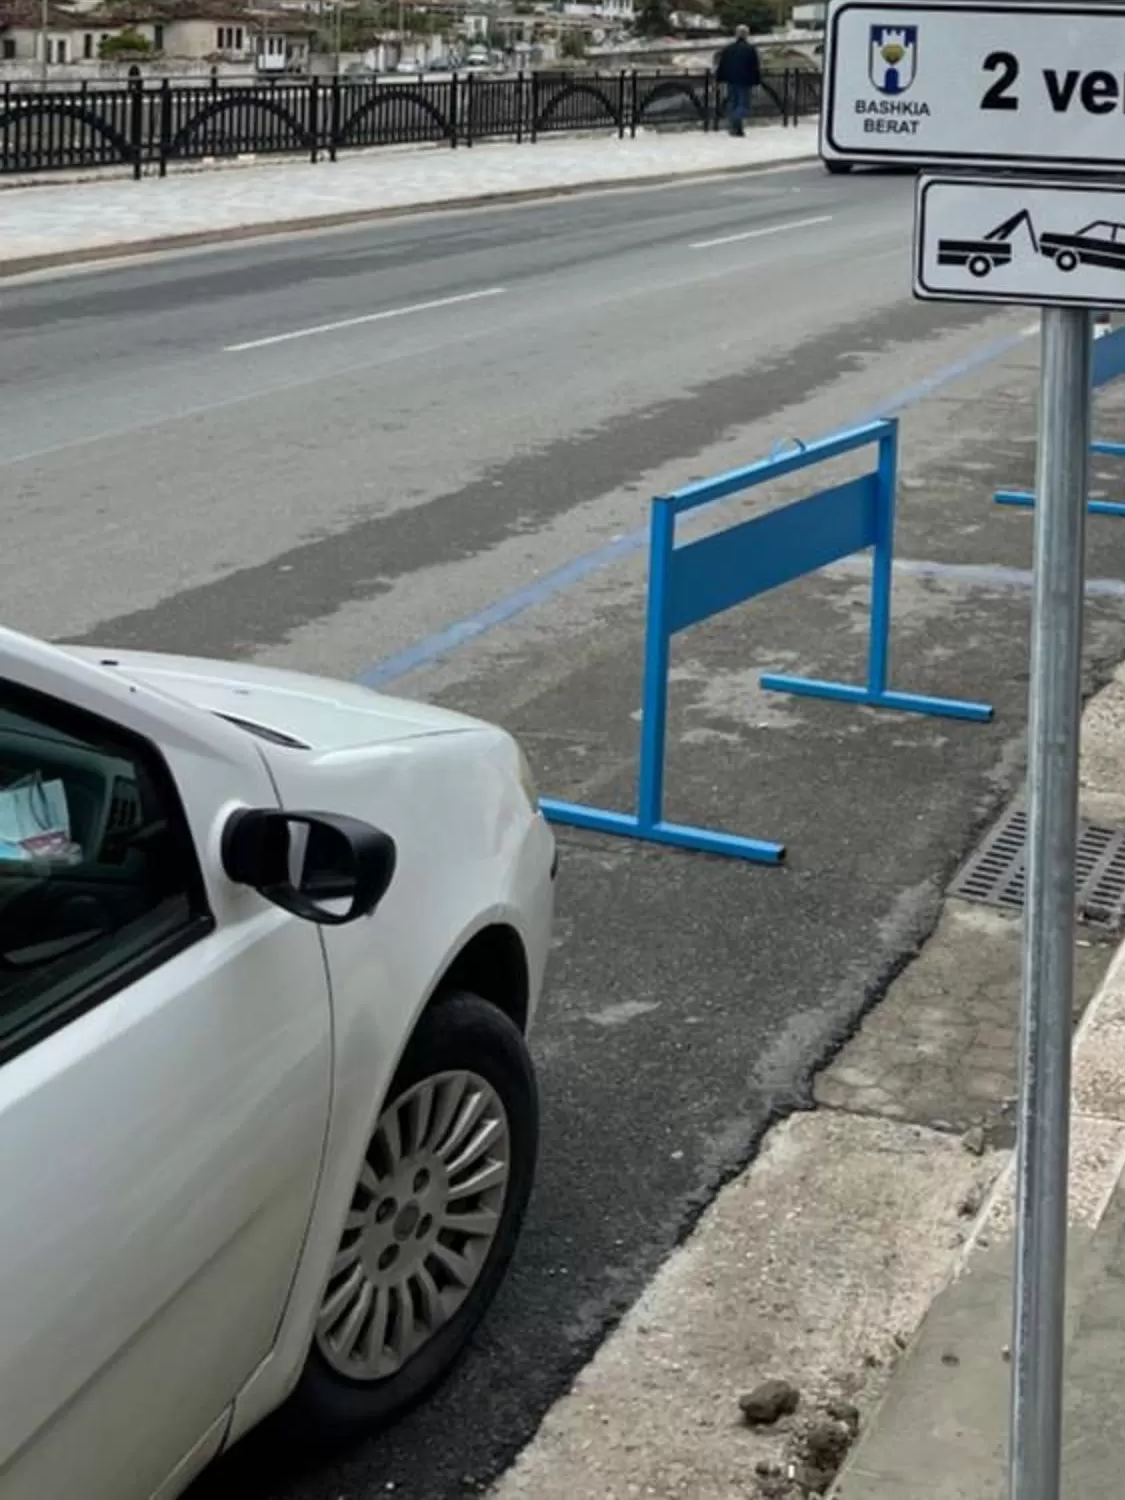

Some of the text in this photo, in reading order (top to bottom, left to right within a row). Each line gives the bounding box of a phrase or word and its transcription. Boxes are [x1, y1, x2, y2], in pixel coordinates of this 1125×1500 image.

[980, 51, 1019, 111] 2
[855, 100, 931, 117] BASHKIA
[863, 118, 919, 136] BERAT
